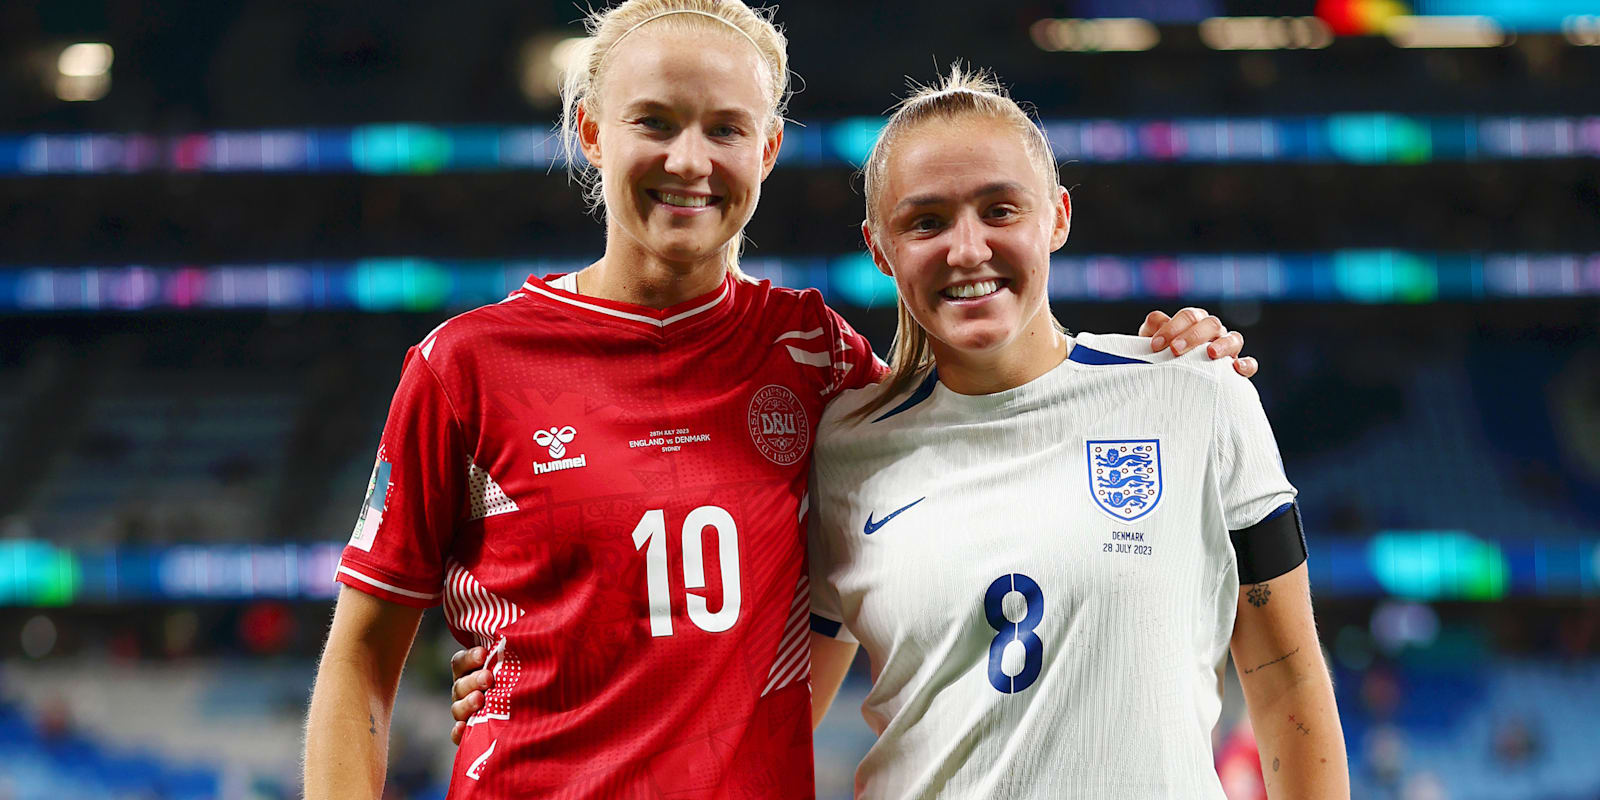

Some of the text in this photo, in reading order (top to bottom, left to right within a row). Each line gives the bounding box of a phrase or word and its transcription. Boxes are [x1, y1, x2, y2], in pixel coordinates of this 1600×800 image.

[760, 411, 797, 435] DBU
[629, 438, 664, 448] ENGLAND
[675, 434, 711, 444] DENMARK
[533, 454, 586, 475] hummel
[774, 452, 797, 463] 1889
[1112, 531, 1144, 542] DENMARK
[1103, 543, 1152, 555] 28 JULY 2023
[631, 505, 742, 638] 10
[984, 573, 1045, 695] 8
